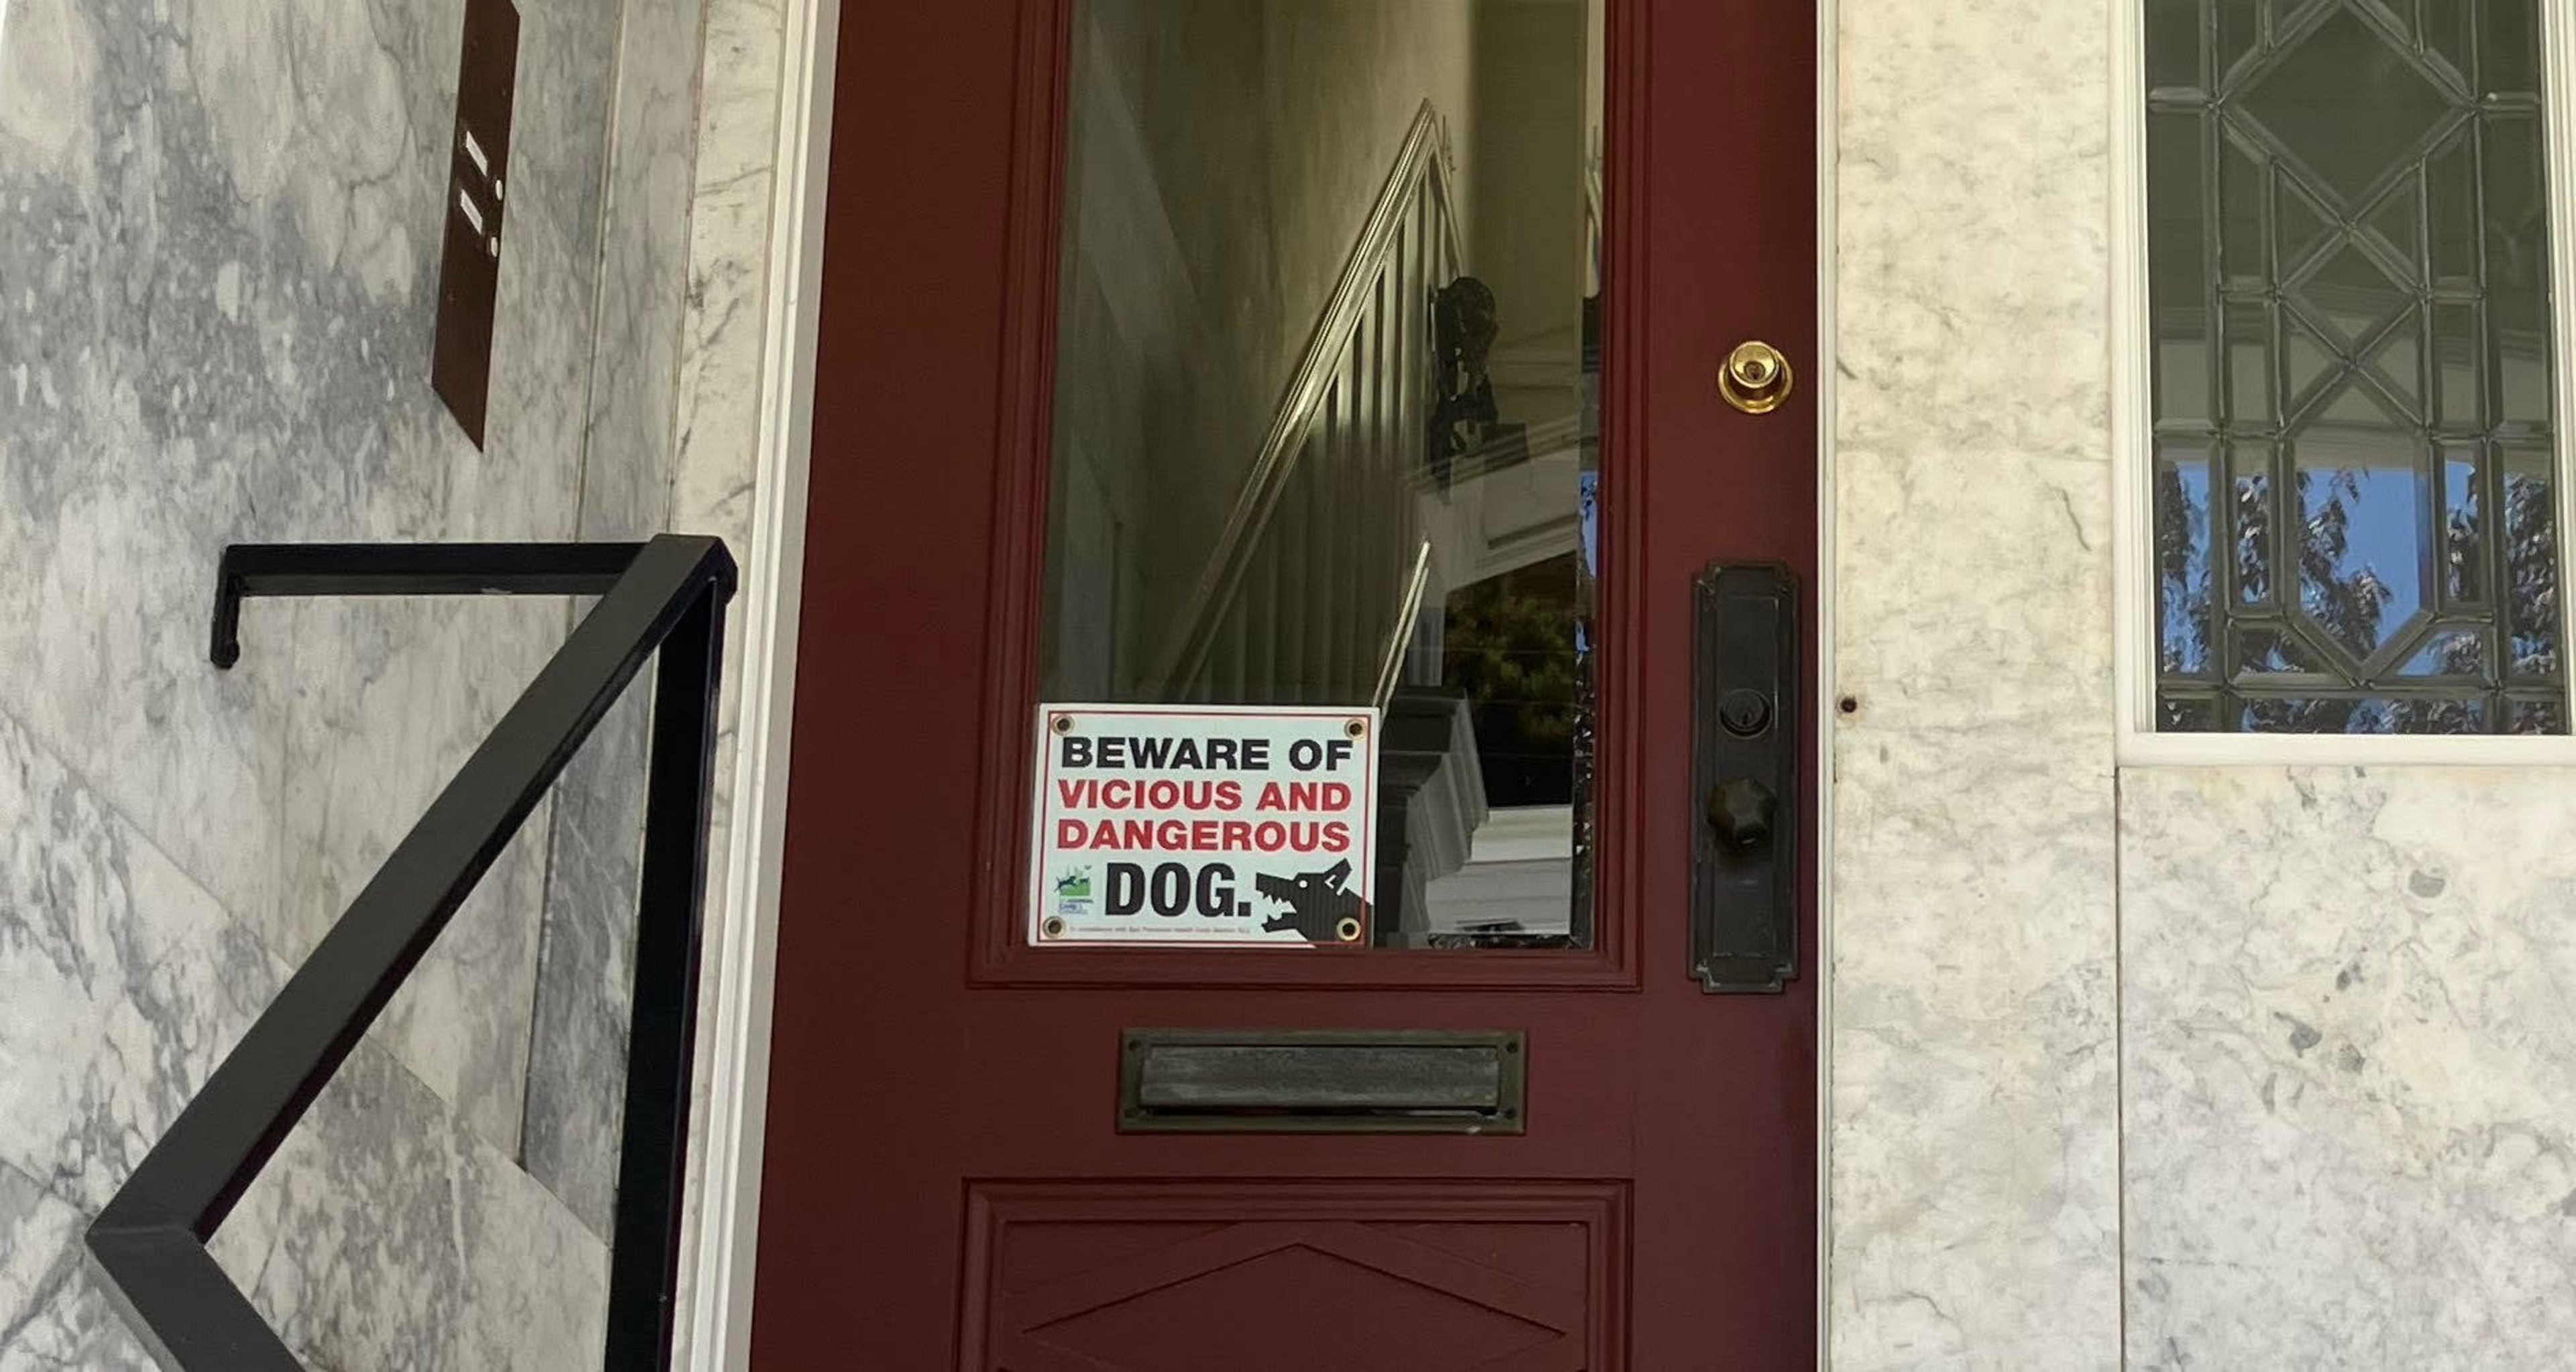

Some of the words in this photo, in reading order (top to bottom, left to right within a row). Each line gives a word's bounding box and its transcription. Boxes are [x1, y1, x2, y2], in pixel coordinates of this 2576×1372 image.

[1061, 736, 1270, 771] BEWARE
[1288, 739, 1353, 772] OF
[1057, 779, 1242, 810] VICIOUS
[1255, 782, 1352, 811] AND
[1057, 819, 1350, 852] DANGEROUS
[1104, 861, 1252, 918] DOG.
